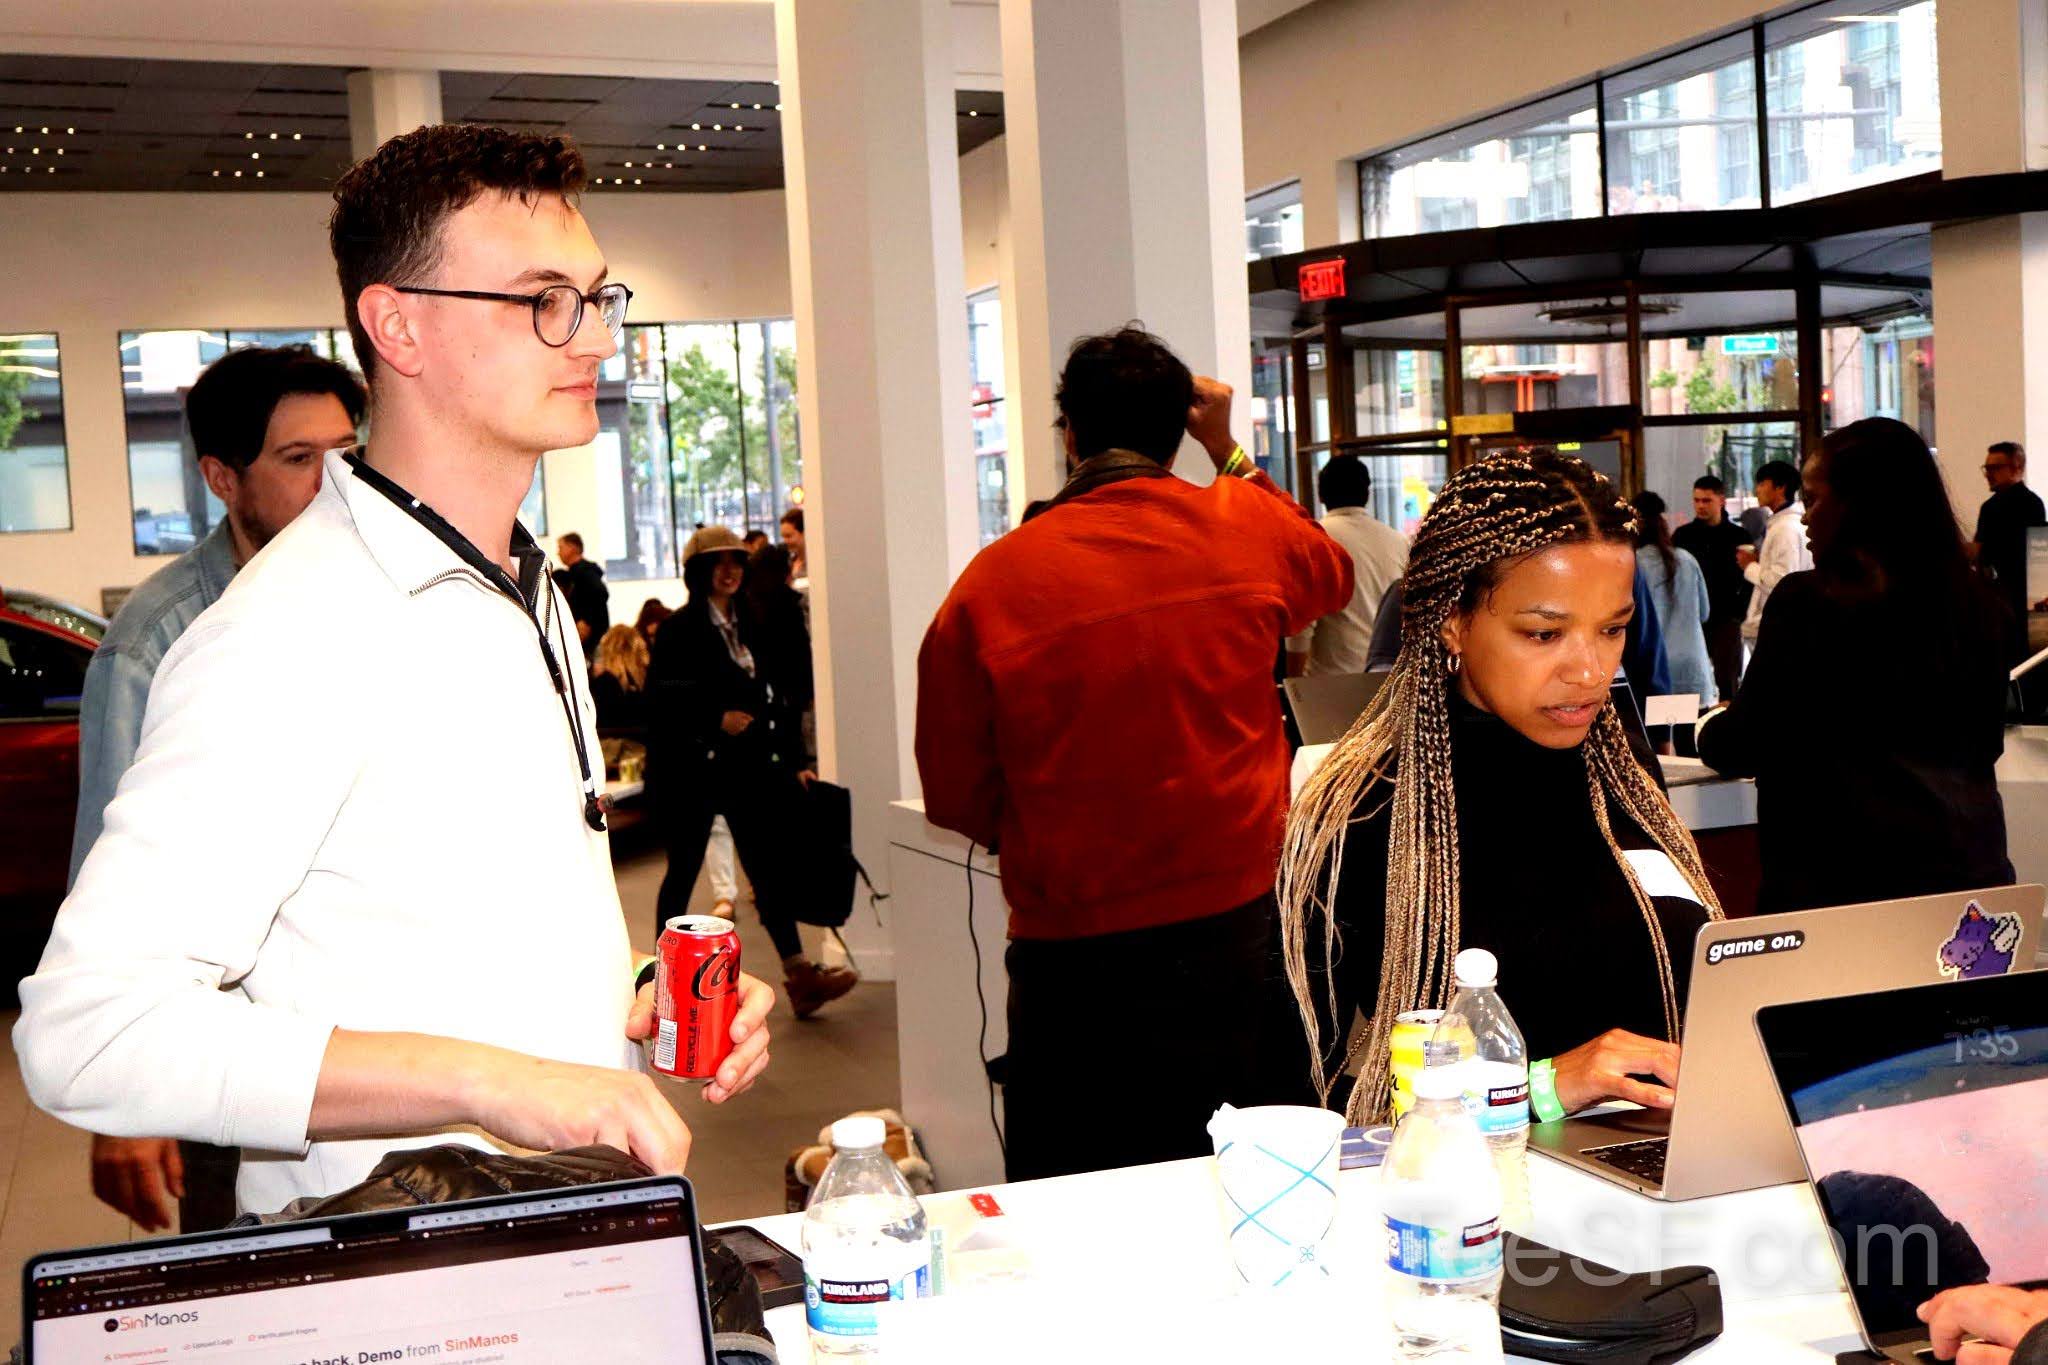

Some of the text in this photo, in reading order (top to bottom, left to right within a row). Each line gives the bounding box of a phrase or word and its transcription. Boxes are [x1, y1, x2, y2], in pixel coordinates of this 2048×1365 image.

[1306, 267, 1336, 297] EXIT
[1709, 934, 1801, 962] game on.
[687, 1007, 698, 1073] RECYCLE ME
[1944, 1024, 2019, 1063] 7:35
[822, 1282, 889, 1296] KIRKLAND
[119, 1311, 199, 1332] SinManos
[358, 1349, 403, 1364] Demo
[406, 1343, 441, 1358] from
[445, 1332, 519, 1352] SinManos
